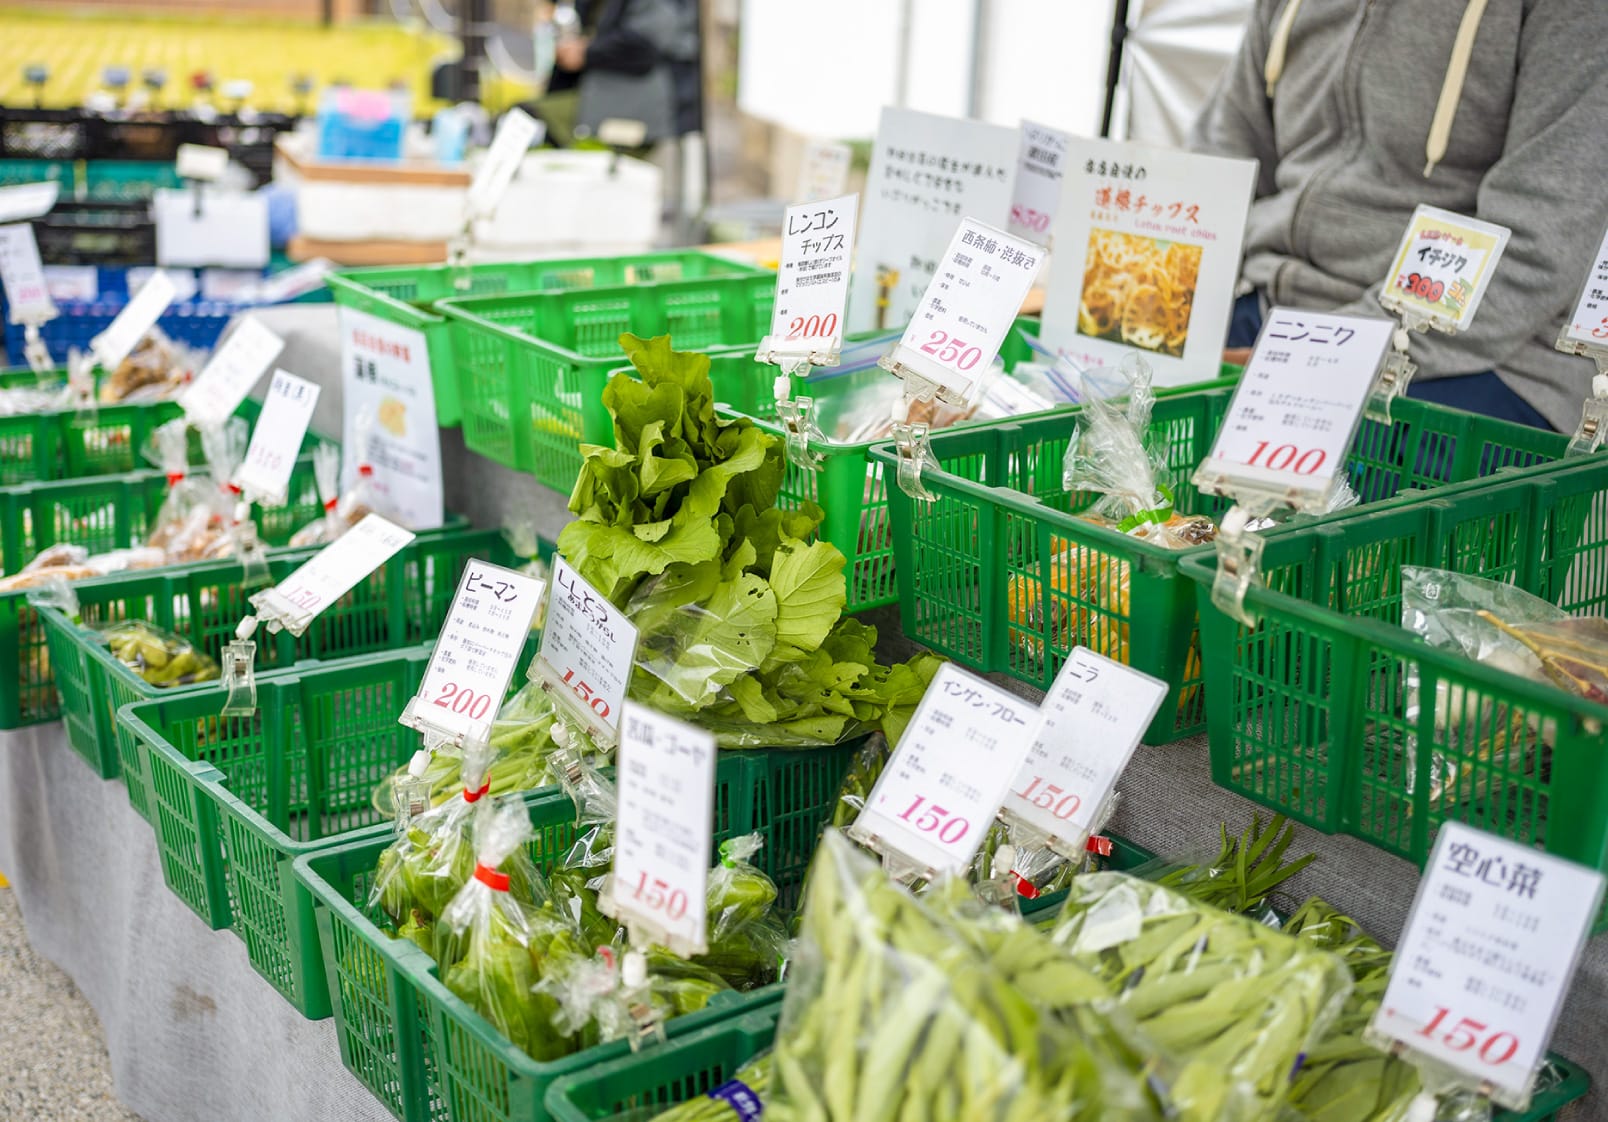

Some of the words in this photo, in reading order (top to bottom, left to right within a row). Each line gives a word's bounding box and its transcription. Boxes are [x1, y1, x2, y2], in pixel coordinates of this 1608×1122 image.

[789, 209, 839, 236] レンコン
[801, 233, 844, 256] チップス
[1418, 246, 1468, 273] イチジク
[1403, 273, 1445, 303] 300
[788, 313, 838, 341] 200
[1268, 319, 1355, 346] ニンニク
[921, 331, 982, 370] 250
[1243, 441, 1327, 475] 100
[465, 570, 518, 602] ピーマン
[558, 568, 609, 623] ししとう
[1069, 661, 1099, 683] ニラ
[433, 683, 492, 720] 200
[562, 667, 611, 718] 150
[1016, 776, 1082, 820] 150
[897, 793, 970, 845] 150
[1443, 842, 1545, 900] 空心菜
[634, 870, 688, 920] 150
[1415, 1004, 1520, 1065] 150
